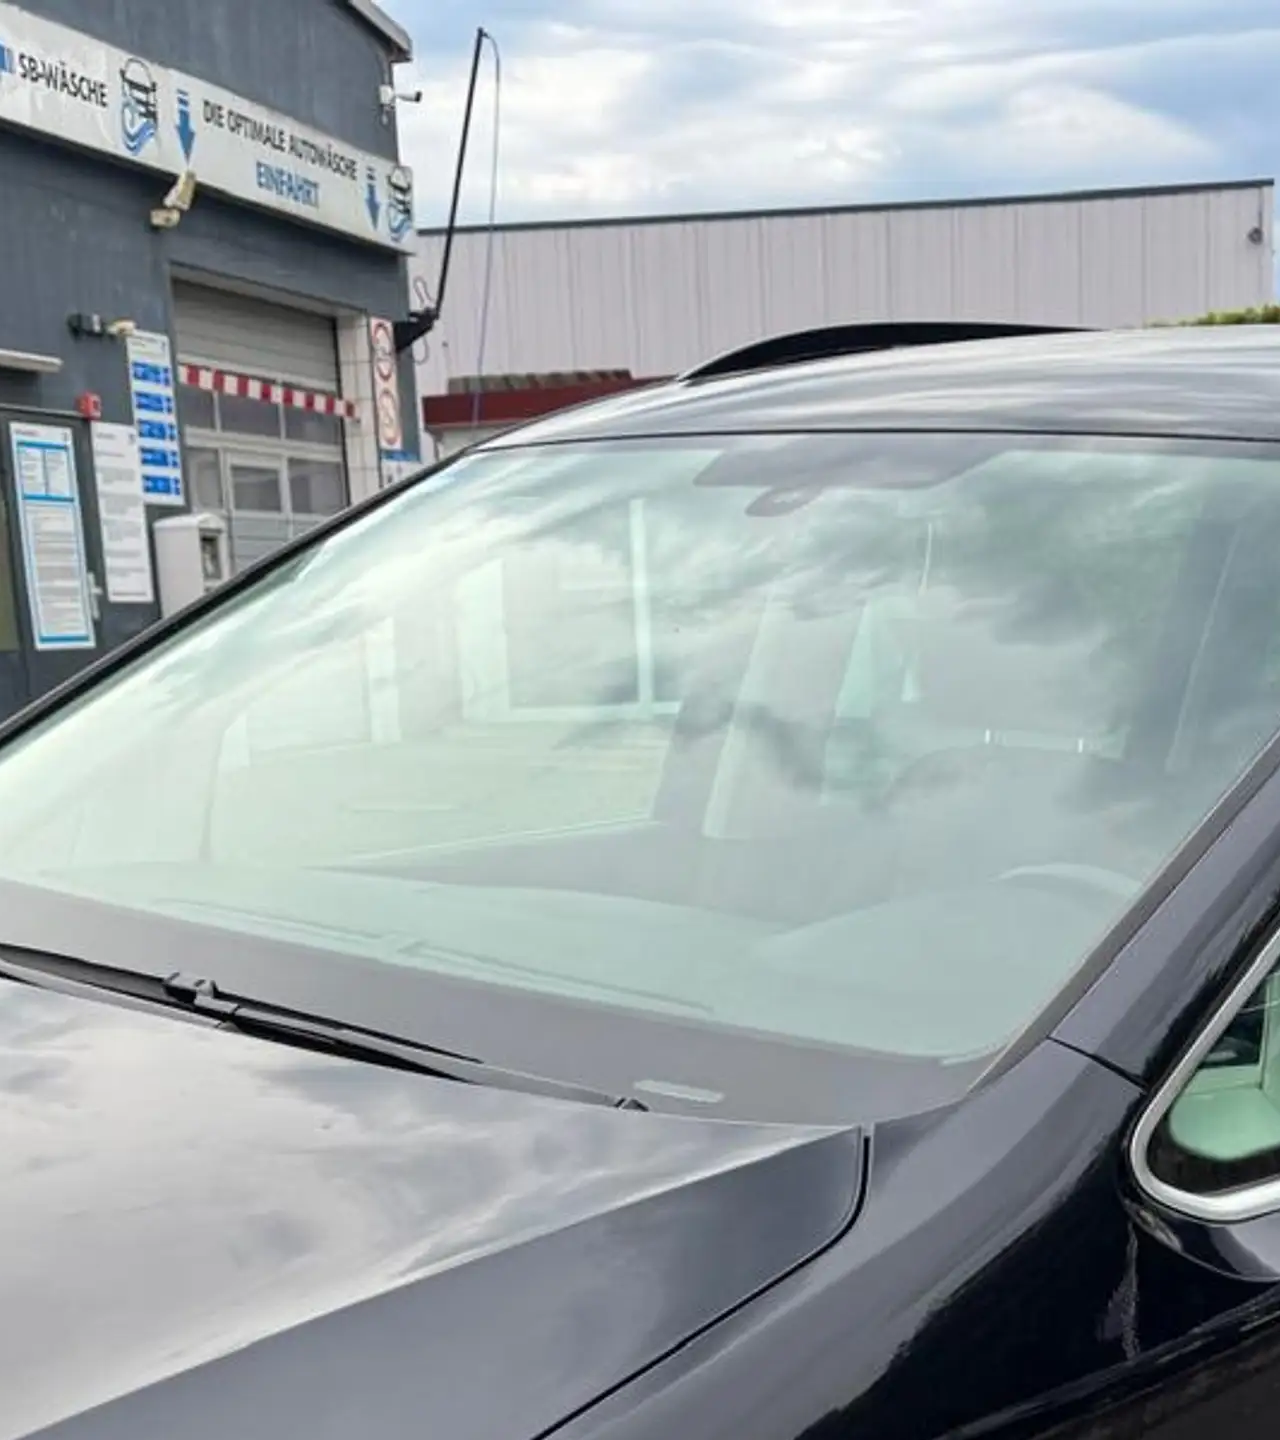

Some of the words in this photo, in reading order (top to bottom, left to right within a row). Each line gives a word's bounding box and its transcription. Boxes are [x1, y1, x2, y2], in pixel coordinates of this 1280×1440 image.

[19, 52, 107, 108] SB-WÄSCHE
[203, 99, 225, 128] DIE
[227, 109, 286, 152] OPTIMALE
[256, 159, 319, 208] EINFAHRT
